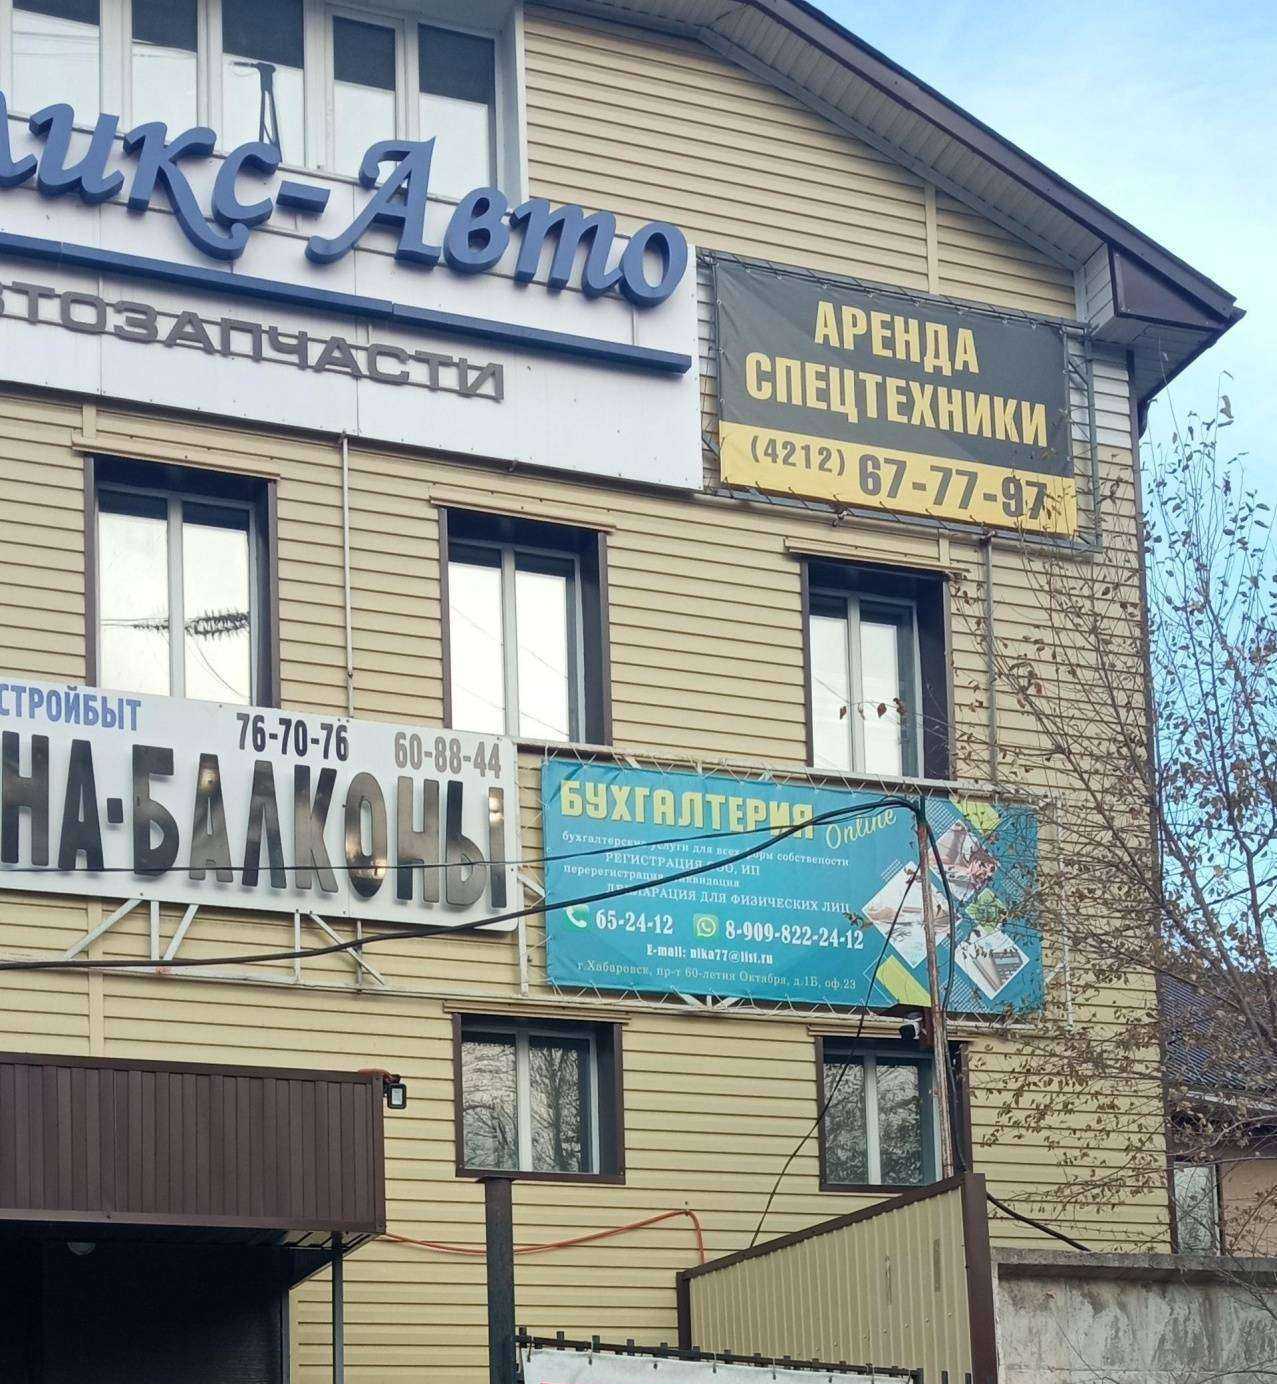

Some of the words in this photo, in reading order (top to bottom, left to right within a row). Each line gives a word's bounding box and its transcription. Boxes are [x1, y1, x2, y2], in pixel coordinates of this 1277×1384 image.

[0, 280, 504, 402] ТОЗАПЧАСТИ
[814, 301, 979, 376] АРЕНДА
[746, 352, 1047, 448] СПЕЦТЕХНИКИ
[751, 435, 845, 476] (4212)
[858, 453, 1047, 520] 67-77-97
[236, 713, 349, 762] 76-70-76
[394, 731, 501, 778] 60-88-44
[561, 780, 814, 839] БУХГАЛТЕРИЯ
[826, 808, 896, 850] Online
[606, 852, 703, 869] РЕГИСТРАЦИЯ
[742, 864, 760, 875] ИП
[693, 845, 712, 854] для
[700, 892, 726, 904] ДЛЯ
[731, 895, 818, 911] ФИЗИЧЕСКИХ
[822, 900, 850, 914] ЛИЦ
[596, 909, 673, 935] 65-24-12
[726, 919, 864, 950] 8-909-822-24-12
[647, 943, 686, 958] E-mail:
[690, 948, 773, 965] nika77@list.ru
[685, 967, 735, 983] 60-летия
